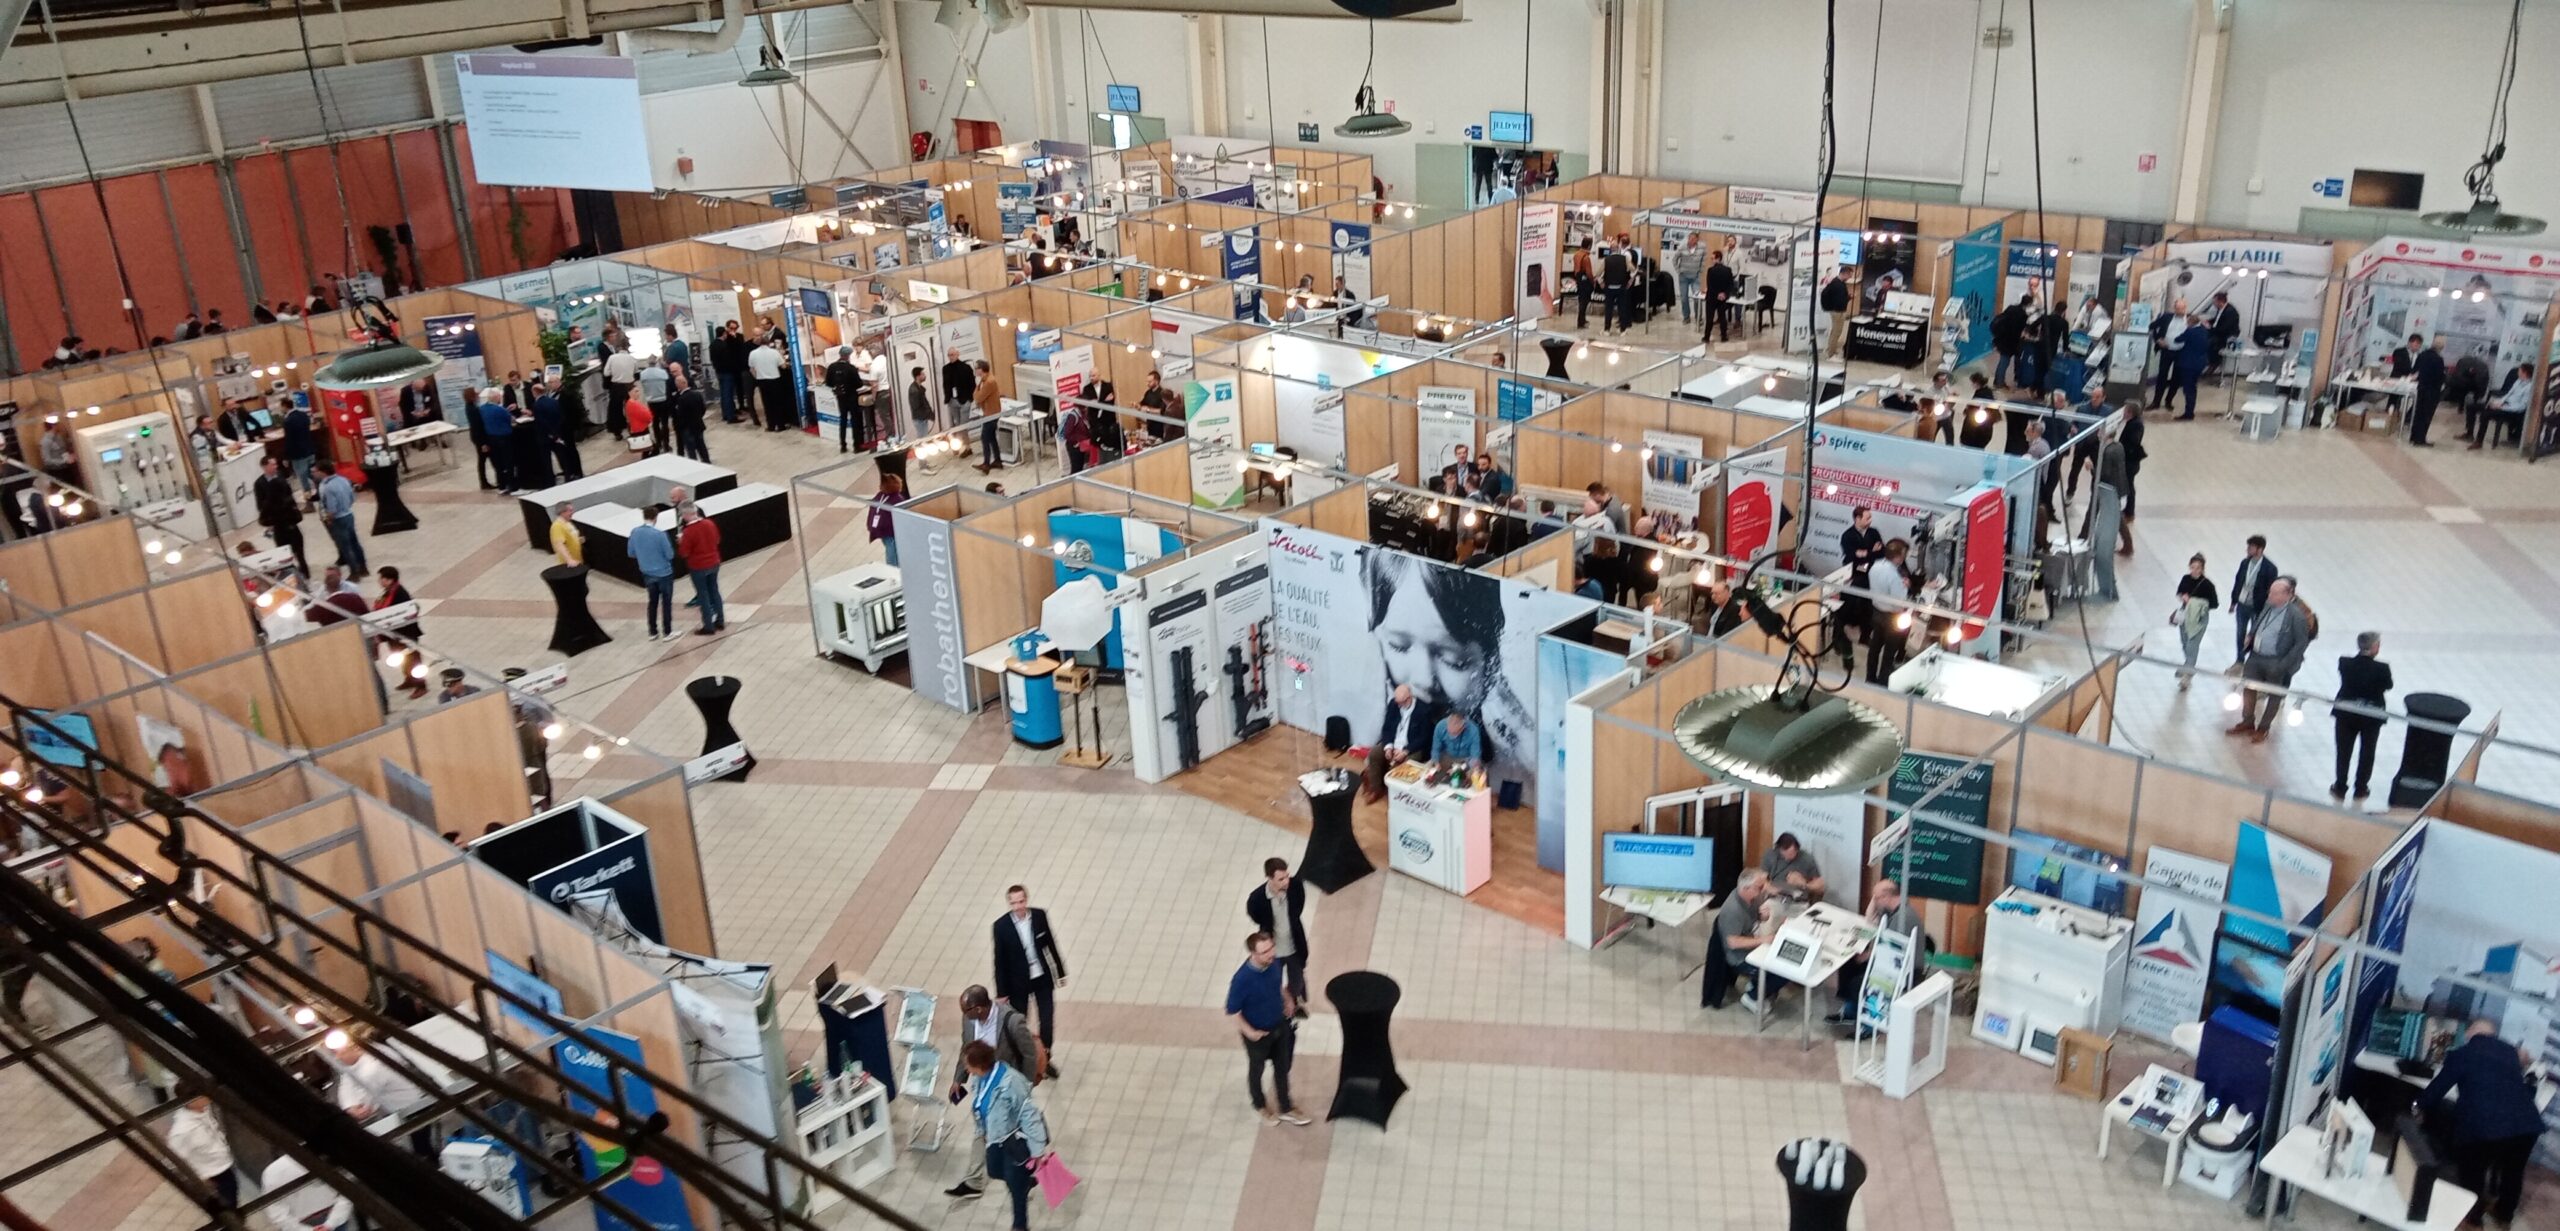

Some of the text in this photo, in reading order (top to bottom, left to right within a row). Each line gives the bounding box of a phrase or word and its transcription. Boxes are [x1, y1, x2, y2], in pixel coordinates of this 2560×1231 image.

[1666, 216, 1708, 229] Honeywell
[2208, 250, 2285, 265] DELABIE
[513, 276, 550, 292] sermes
[1856, 326, 1909, 344] Honeywell
[1427, 391, 1466, 401] PRESTO
[1828, 437, 1868, 453] spirec
[1811, 468, 1872, 486] PRODUCTION
[1822, 492, 1878, 511] PUISSANCE
[1286, 583, 1331, 609] QUALITÉ
[927, 532, 961, 708] robatherm
[569, 855, 637, 893] Tarkett
[2149, 859, 2223, 891] Capots de
